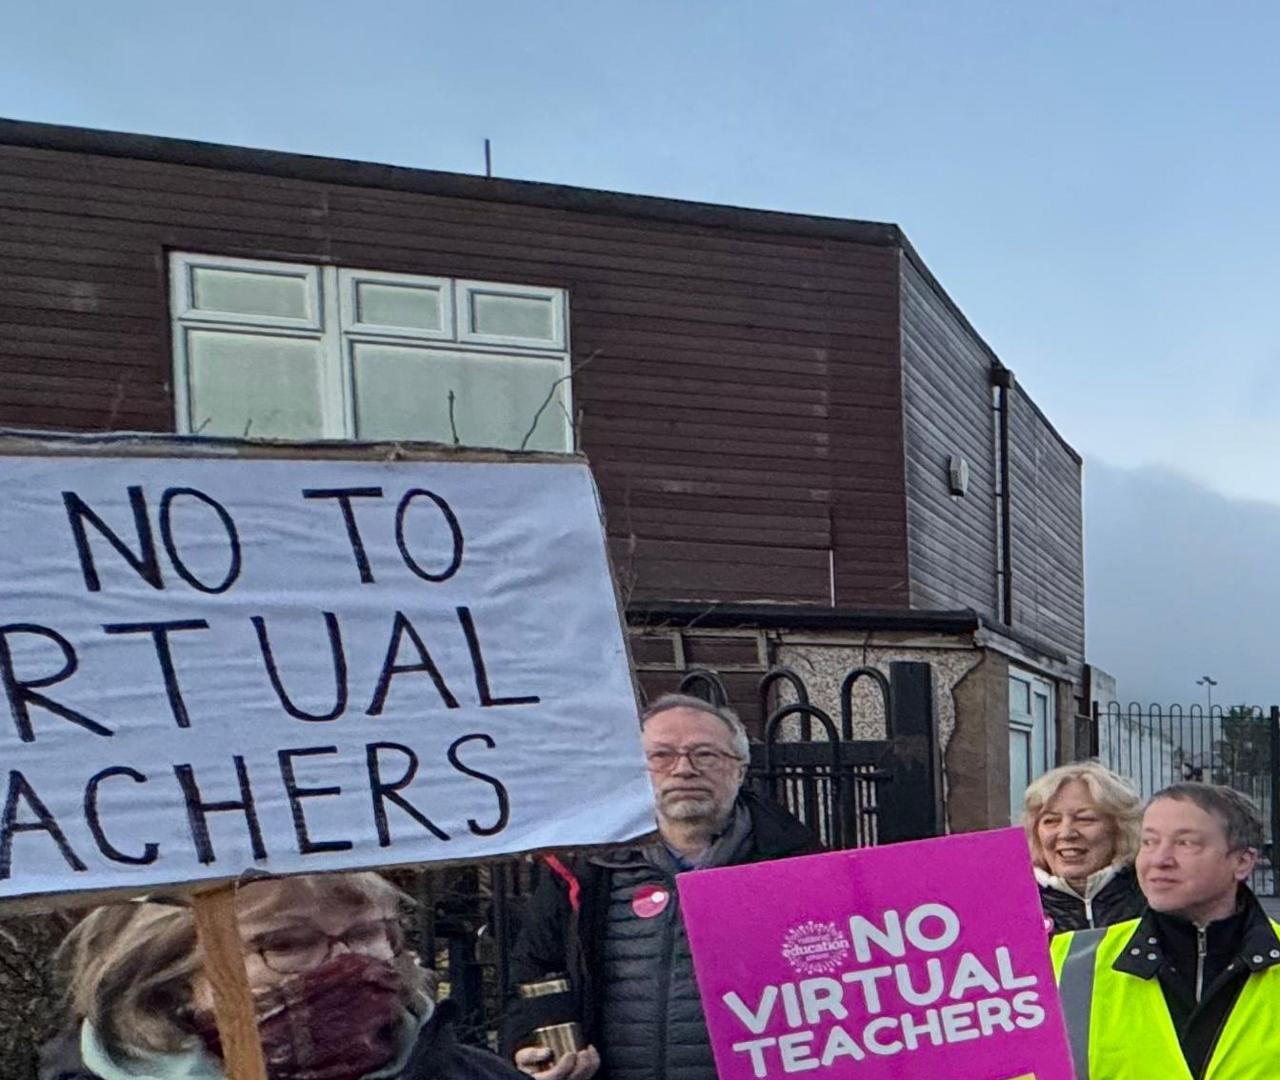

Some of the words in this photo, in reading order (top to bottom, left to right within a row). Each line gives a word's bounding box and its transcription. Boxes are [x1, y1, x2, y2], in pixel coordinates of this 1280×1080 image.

[62, 486, 241, 594] NO
[302, 486, 463, 584] TO
[0, 606, 541, 742] RTUAL
[0, 733, 510, 879] ACHERS
[849, 903, 960, 963] NO
[722, 947, 1038, 1034] VIRTUAL
[732, 991, 1046, 1078] TEACHERS
